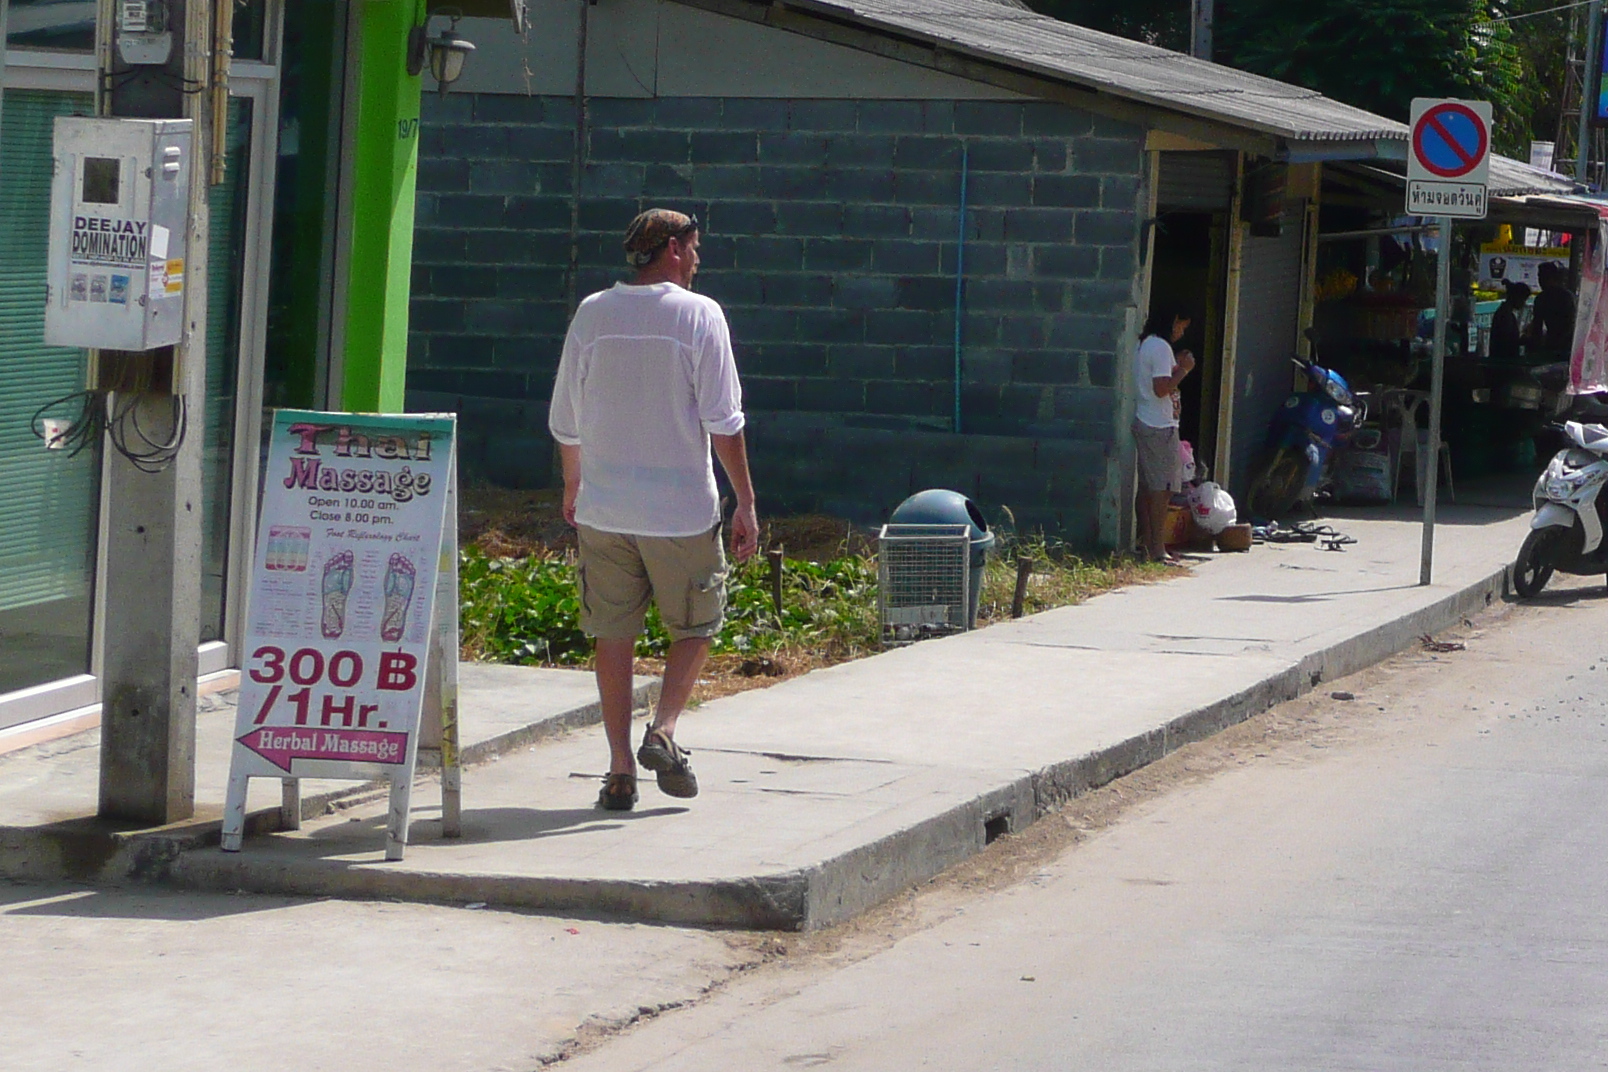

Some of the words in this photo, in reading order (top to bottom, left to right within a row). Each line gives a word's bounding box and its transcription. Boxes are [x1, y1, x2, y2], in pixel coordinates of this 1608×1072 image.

[75, 216, 147, 234] DEEJAY
[72, 230, 147, 258] DOMINATION
[287, 422, 432, 461] Thai
[283, 457, 432, 503] Massage
[308, 495, 340, 510] Open
[345, 498, 375, 510] 10.00
[377, 501, 400, 511] am.
[309, 510, 342, 523] Close
[345, 512, 369, 523] 8.00
[372, 514, 395, 526] pm.
[395, 531, 421, 542] Chart
[249, 645, 364, 688] 300
[258, 730, 317, 751] Herbal
[321, 733, 399, 759] Massage
